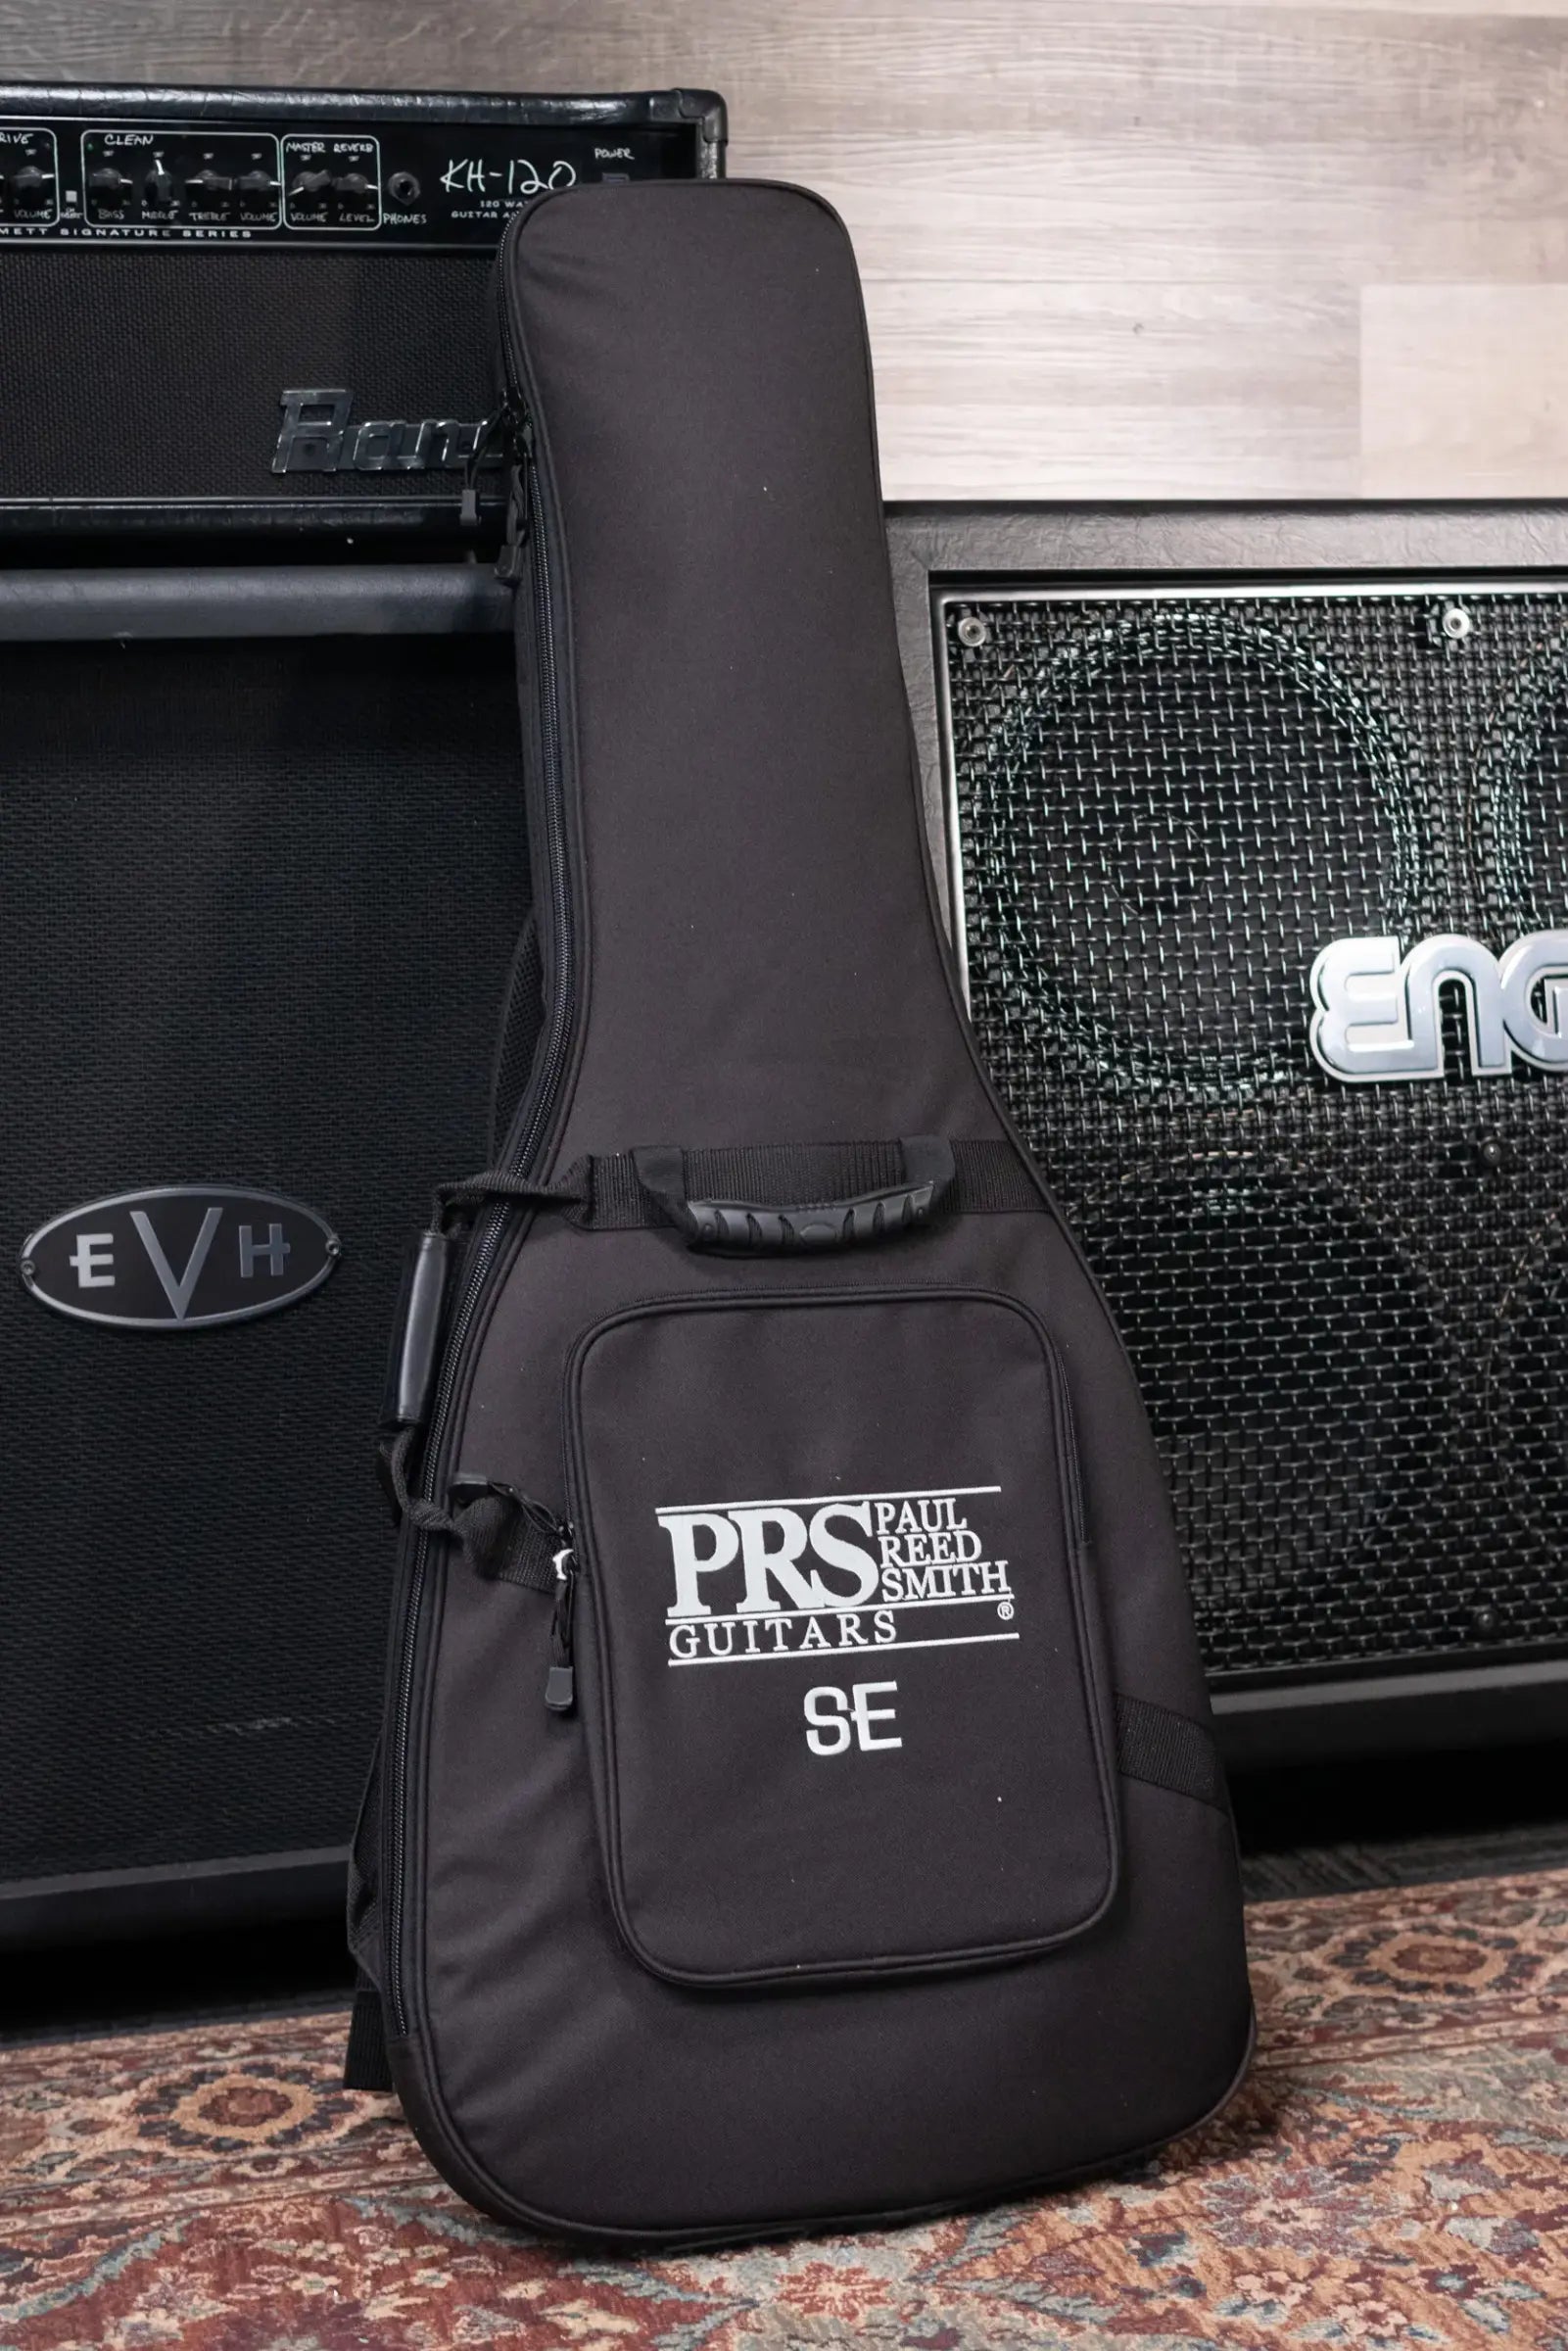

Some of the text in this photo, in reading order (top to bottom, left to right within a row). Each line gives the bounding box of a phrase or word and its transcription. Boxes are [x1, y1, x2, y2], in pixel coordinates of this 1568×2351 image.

[104, 133, 154, 146] CLEAN
[286, 141, 326, 153] MASTER
[333, 143, 373, 153] REVERB
[594, 148, 635, 160] POWER
[441, 159, 576, 194] KH-120
[383, 213, 427, 224] PHONES
[480, 200, 500, 209] 120
[60, 227, 171, 237] SIGNATURE
[182, 229, 252, 238] SERIES
[70, 1208, 291, 1321] EVH
[875, 1498, 968, 1535] PAUL
[657, 1500, 880, 1618] PRS
[879, 1530, 982, 1568] REED
[881, 1559, 1013, 1603] SMITH
[669, 1609, 898, 1658] GUITARS
[803, 1680, 903, 1756] SE
